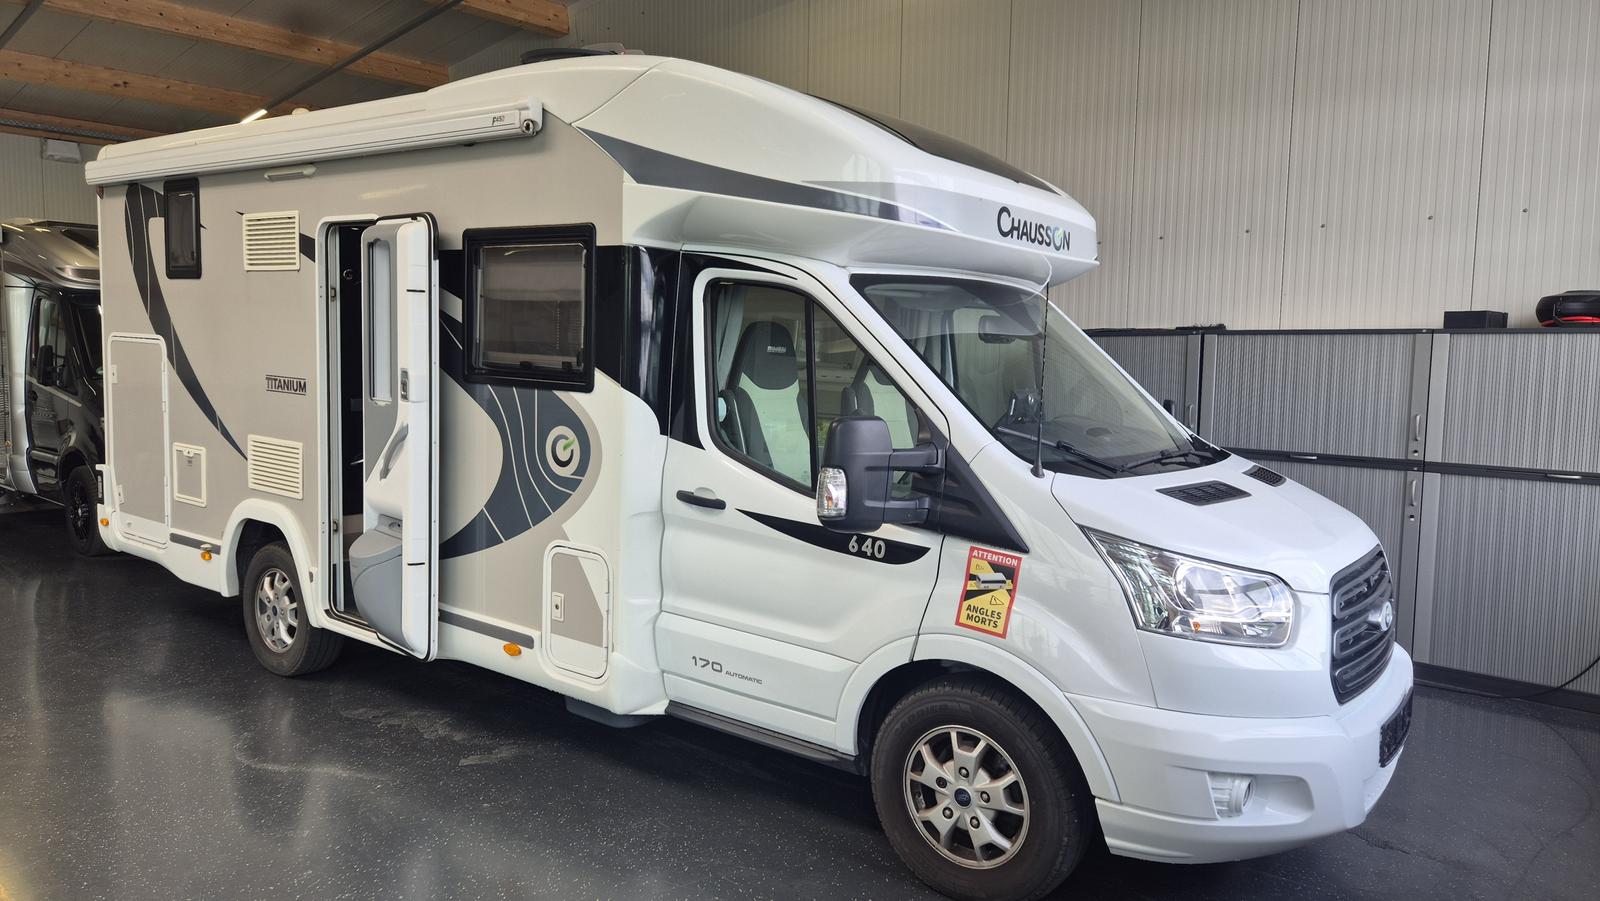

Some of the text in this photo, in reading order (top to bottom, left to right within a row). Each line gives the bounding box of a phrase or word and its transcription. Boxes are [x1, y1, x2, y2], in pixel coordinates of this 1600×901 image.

[997, 206, 1070, 251] CHAUSSON
[265, 377, 307, 393] TITANIUM
[848, 535, 886, 559] 640
[972, 550, 1018, 567] ATTENTION
[966, 604, 1002, 620] ANGLES
[966, 613, 999, 628] MORTS
[692, 656, 763, 684] 170 AUTOMATIC
